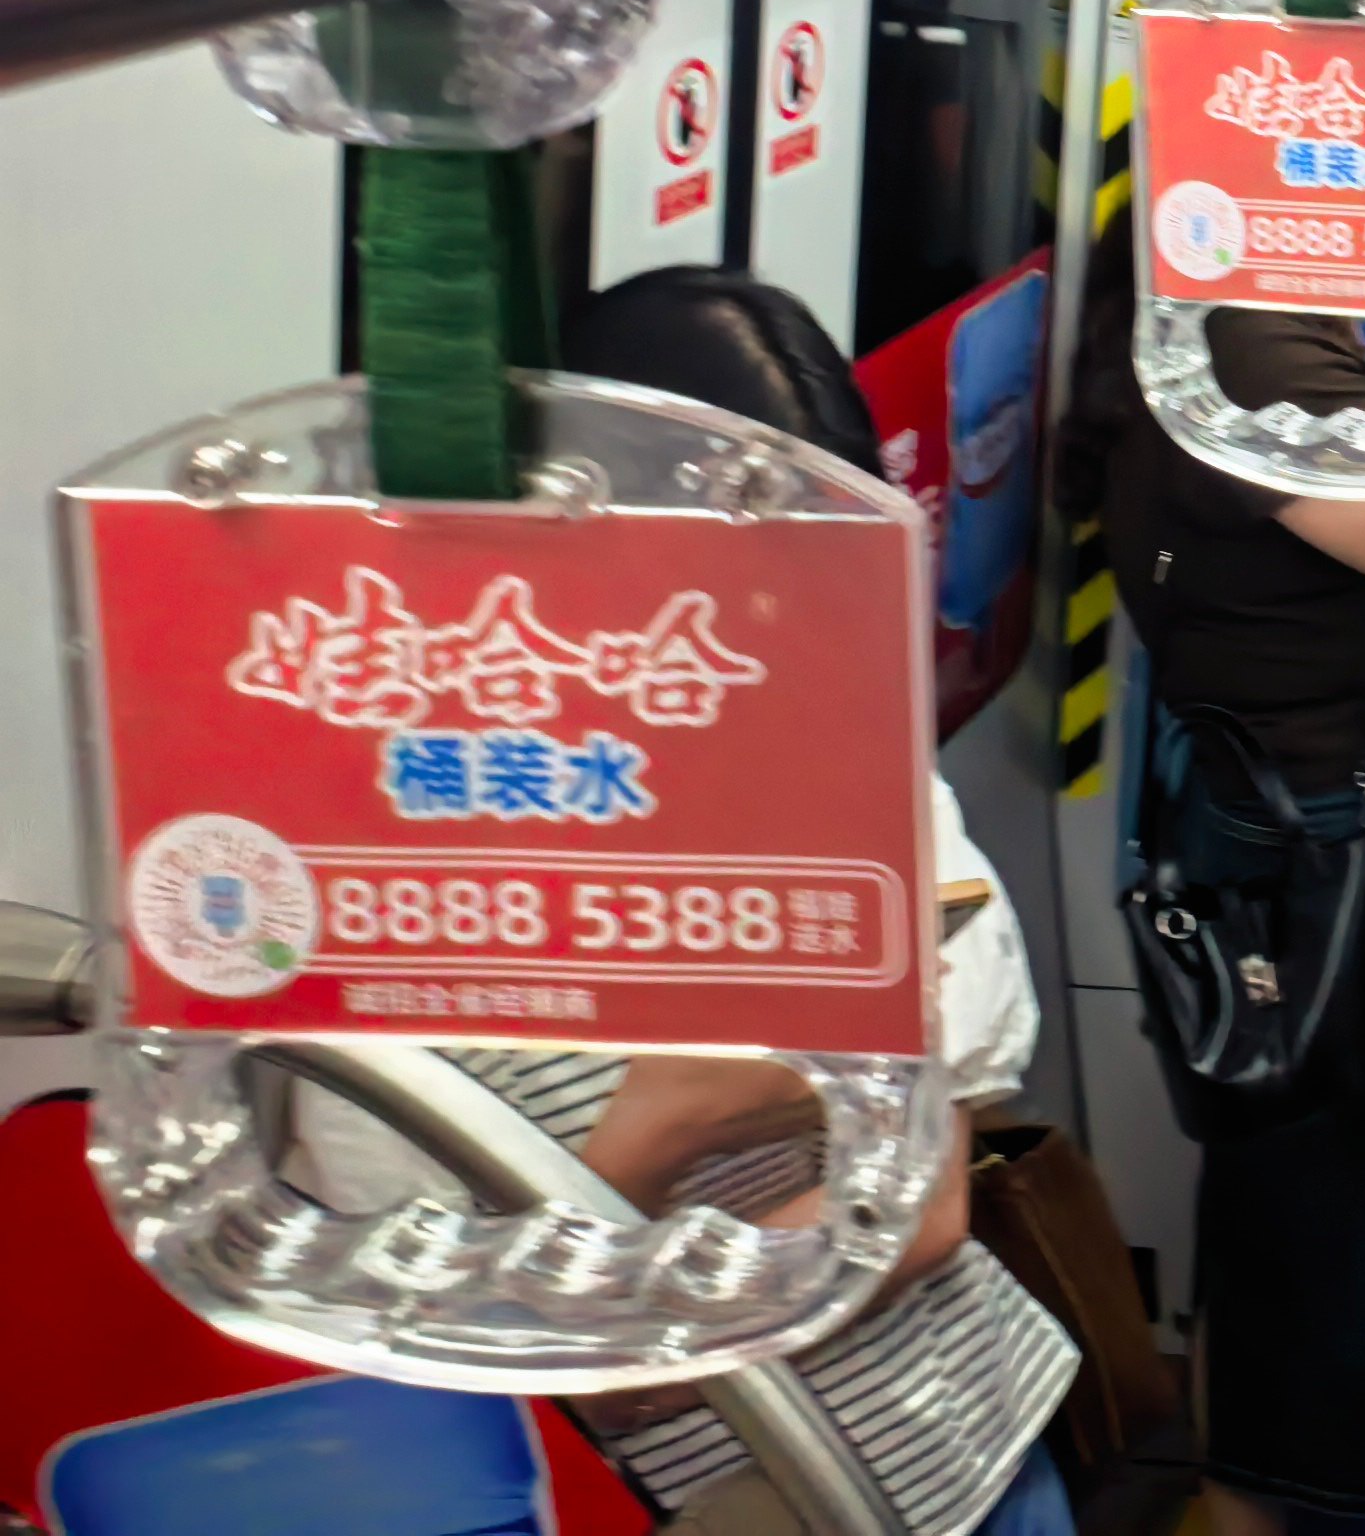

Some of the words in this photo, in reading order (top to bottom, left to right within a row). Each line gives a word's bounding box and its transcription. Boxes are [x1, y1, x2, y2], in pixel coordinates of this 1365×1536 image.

[1247, 216, 1355, 258] 8888
[228, 566, 764, 727] 娃哈哈
[383, 728, 655, 822] 桶装水
[330, 879, 547, 946] 8888
[570, 885, 782, 954] 5388
